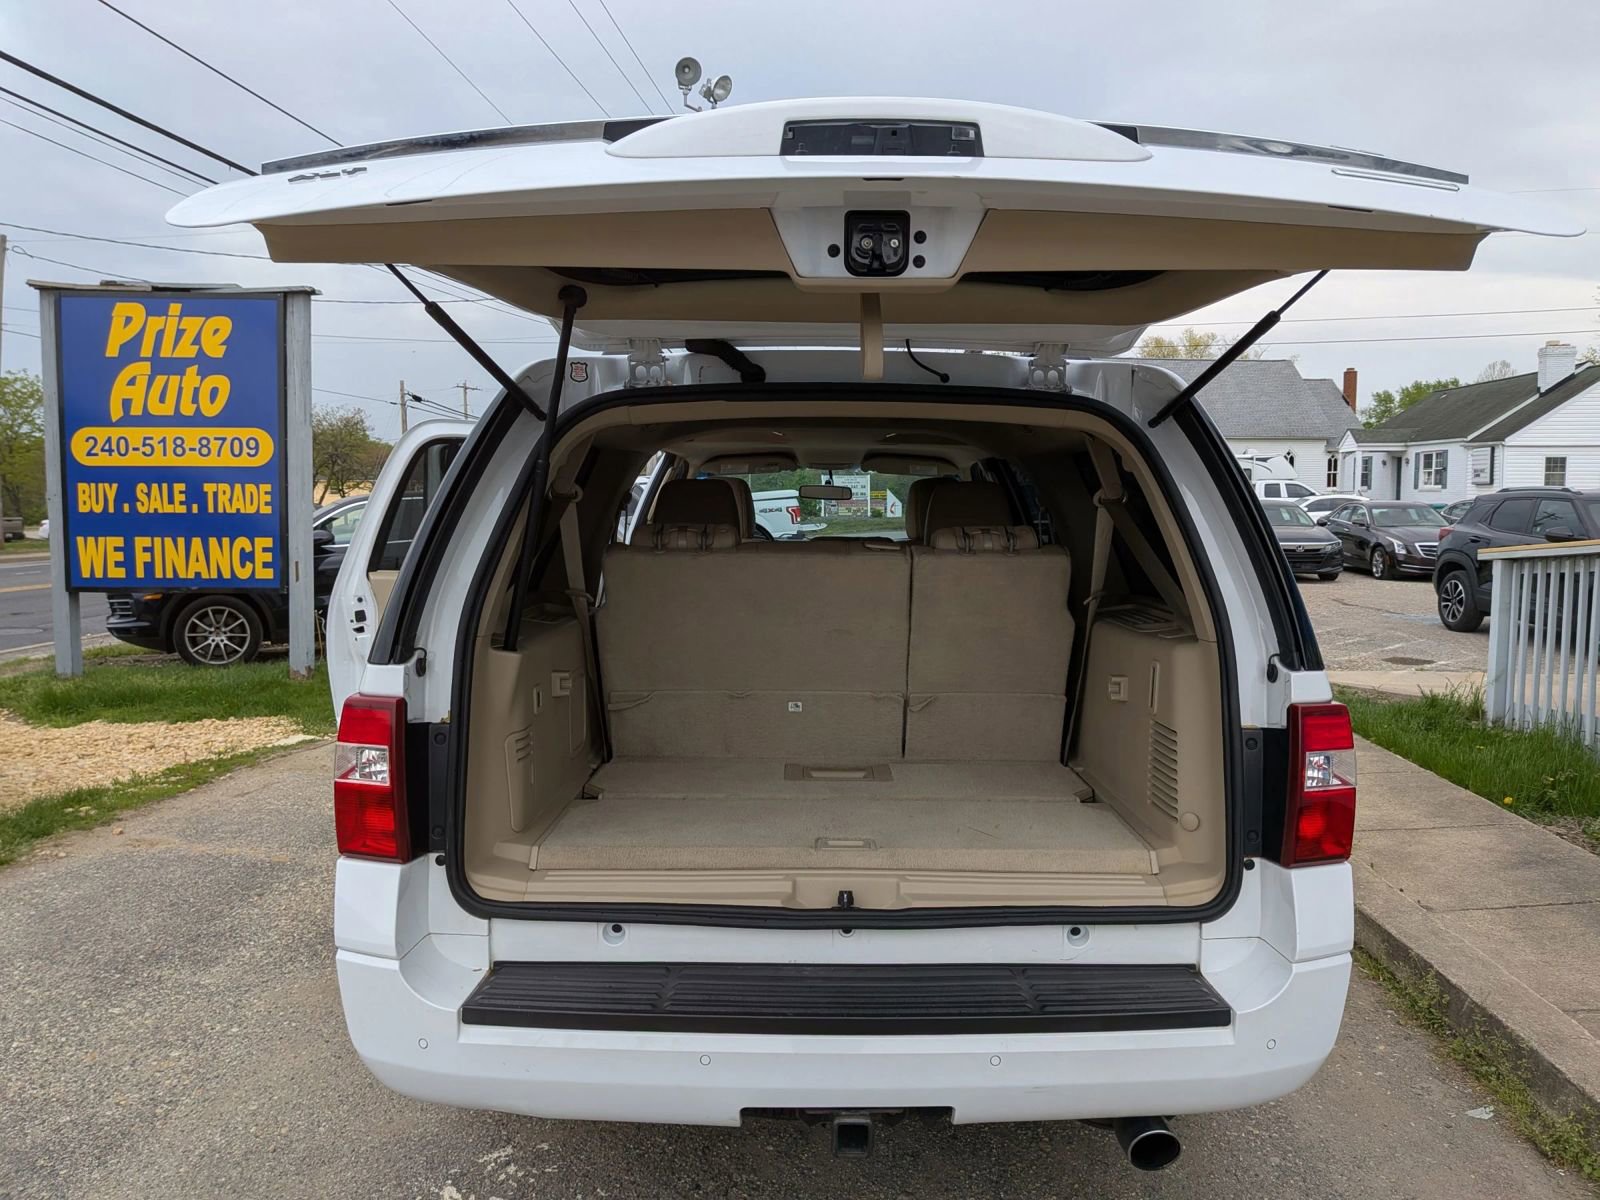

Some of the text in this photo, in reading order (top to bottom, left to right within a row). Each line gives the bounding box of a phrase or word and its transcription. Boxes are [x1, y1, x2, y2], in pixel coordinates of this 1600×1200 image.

[105, 302, 233, 358] Prize
[109, 361, 231, 423] Auto
[85, 435, 260, 458] 240-518-8709
[77, 482, 118, 513] BUY
[136, 482, 187, 513] SALE
[203, 483, 272, 514] TRADE
[76, 536, 274, 579] WE FINANCE
